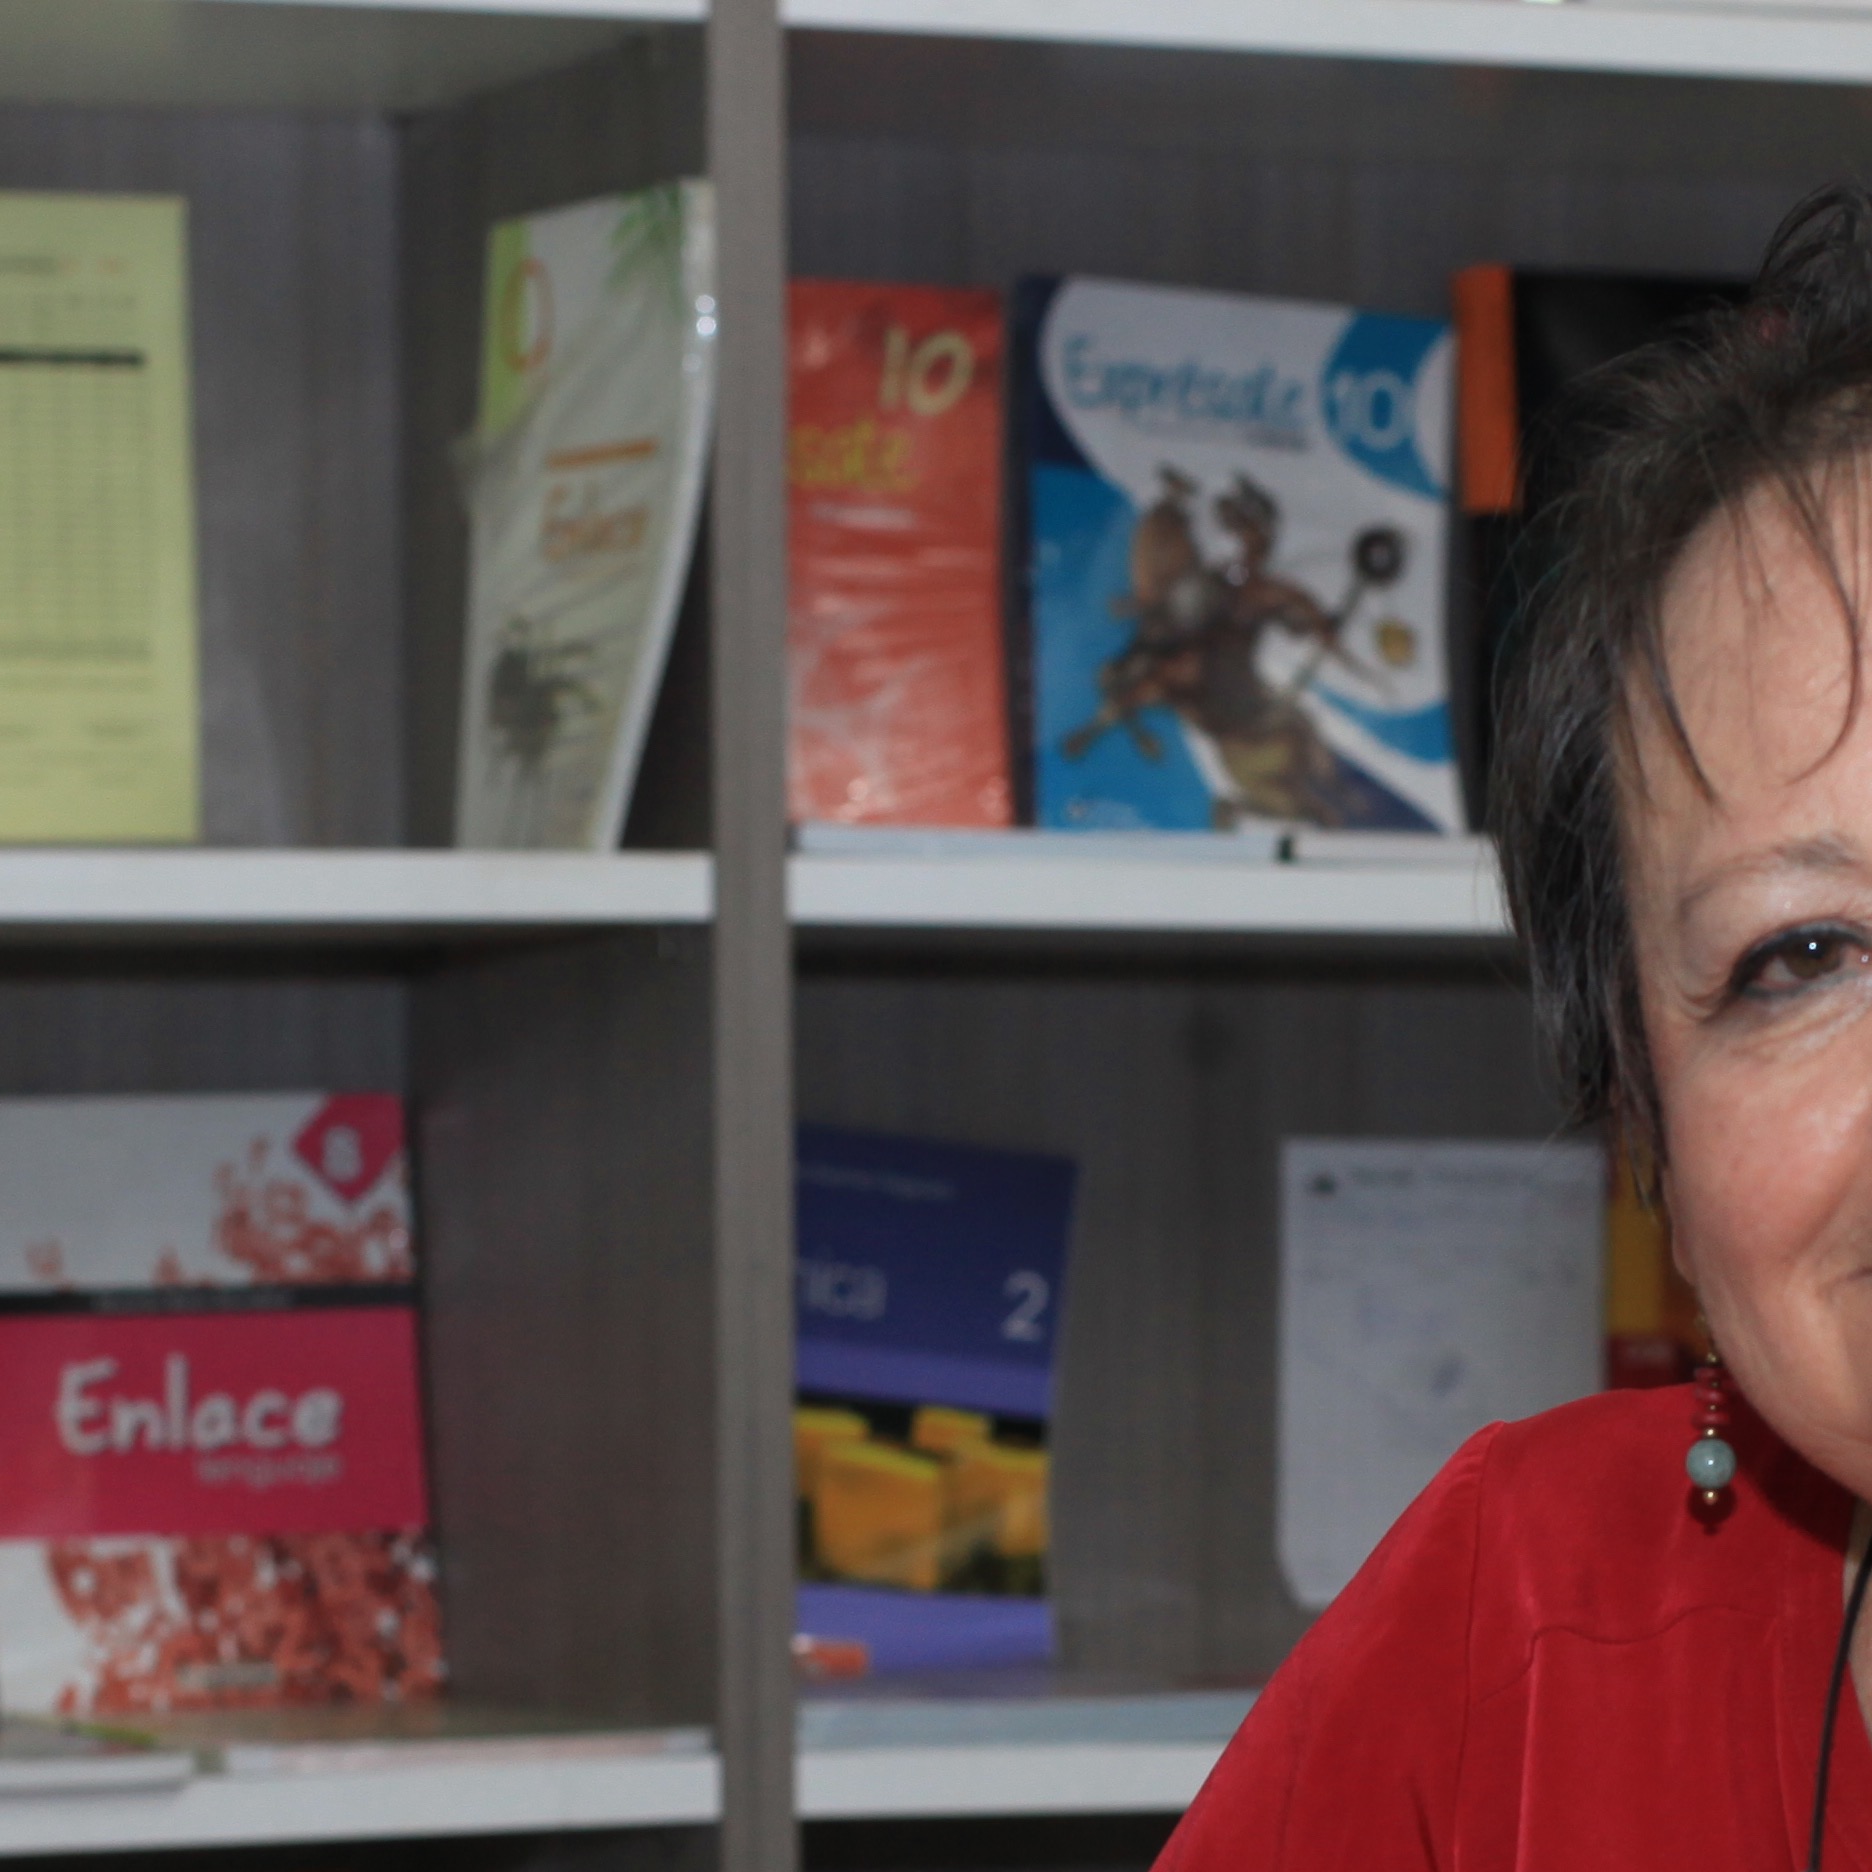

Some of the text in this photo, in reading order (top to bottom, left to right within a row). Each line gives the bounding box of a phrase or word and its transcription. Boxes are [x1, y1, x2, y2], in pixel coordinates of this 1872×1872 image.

[880, 322, 974, 417] 10
[1331, 368, 1420, 452] 10
[1001, 1270, 1050, 1342] 2
[54, 1353, 345, 1458] Enlace
